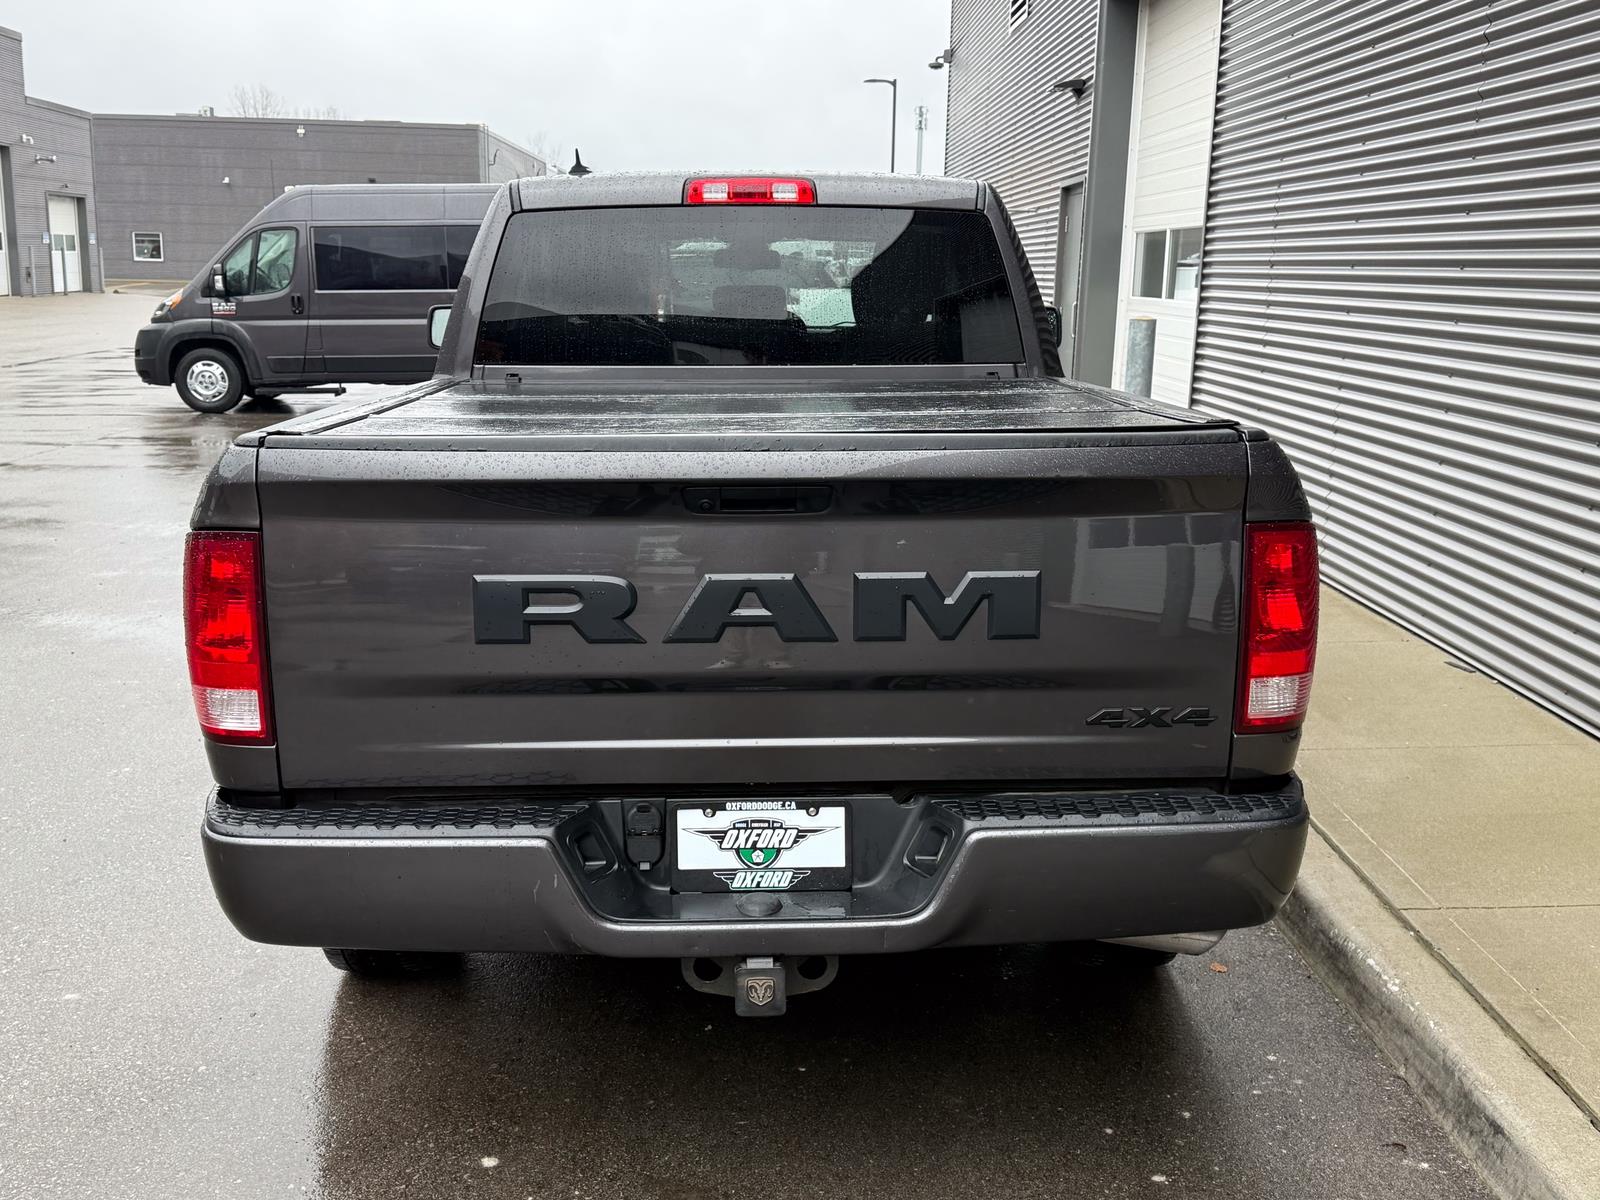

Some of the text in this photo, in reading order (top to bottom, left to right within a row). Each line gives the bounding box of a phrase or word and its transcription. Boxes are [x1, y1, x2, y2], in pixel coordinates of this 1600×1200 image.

[472, 569, 1041, 645] RAM
[1085, 706, 1217, 728] 4X4
[725, 801, 797, 811] OXFORDDODGE.CA
[721, 829, 798, 848] OXFORD
[732, 871, 793, 887] OXFORD
